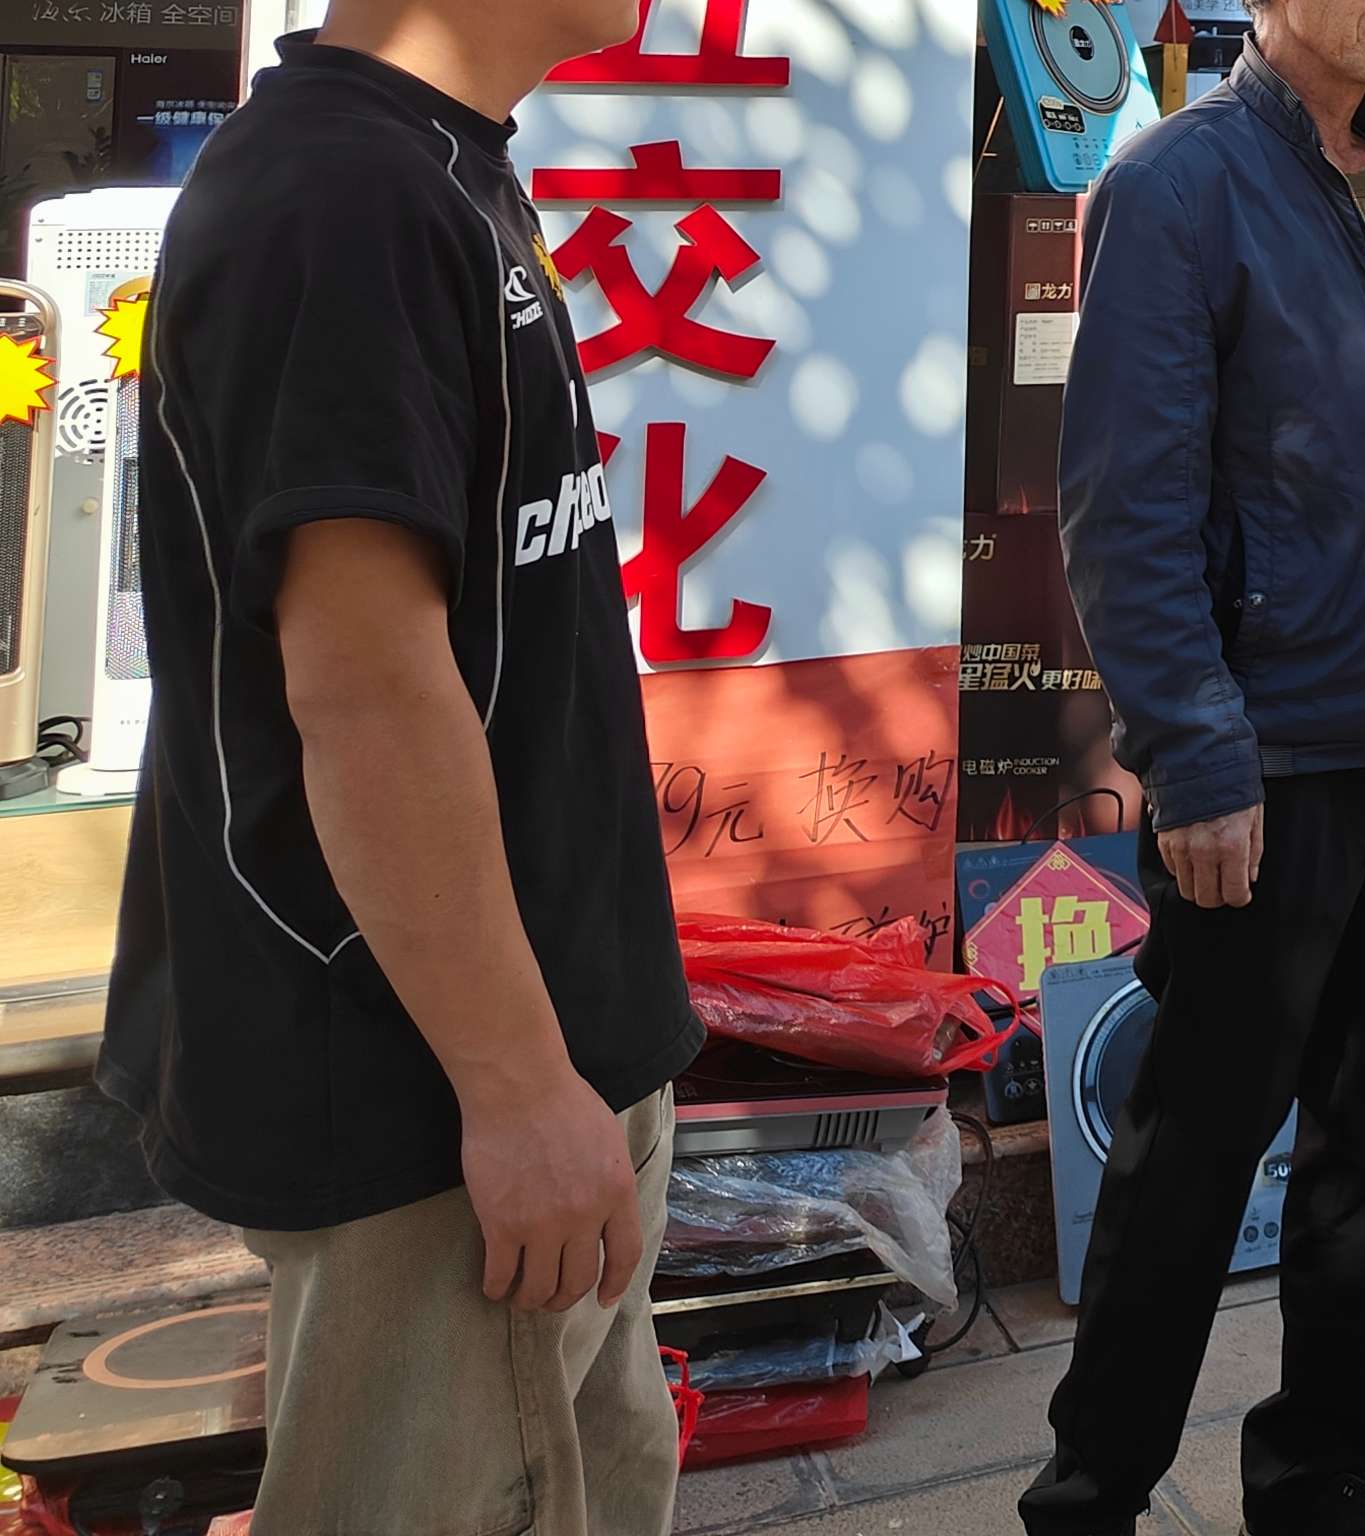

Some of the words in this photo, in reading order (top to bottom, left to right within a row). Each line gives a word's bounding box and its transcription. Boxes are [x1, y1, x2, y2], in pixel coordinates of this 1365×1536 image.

[99, 1, 152, 24] 冰箱
[161, 4, 238, 26] 全空间
[130, 53, 168, 65] Haier
[962, 759, 1012, 777] 电磁炉
[798, 750, 955, 842] 换购
